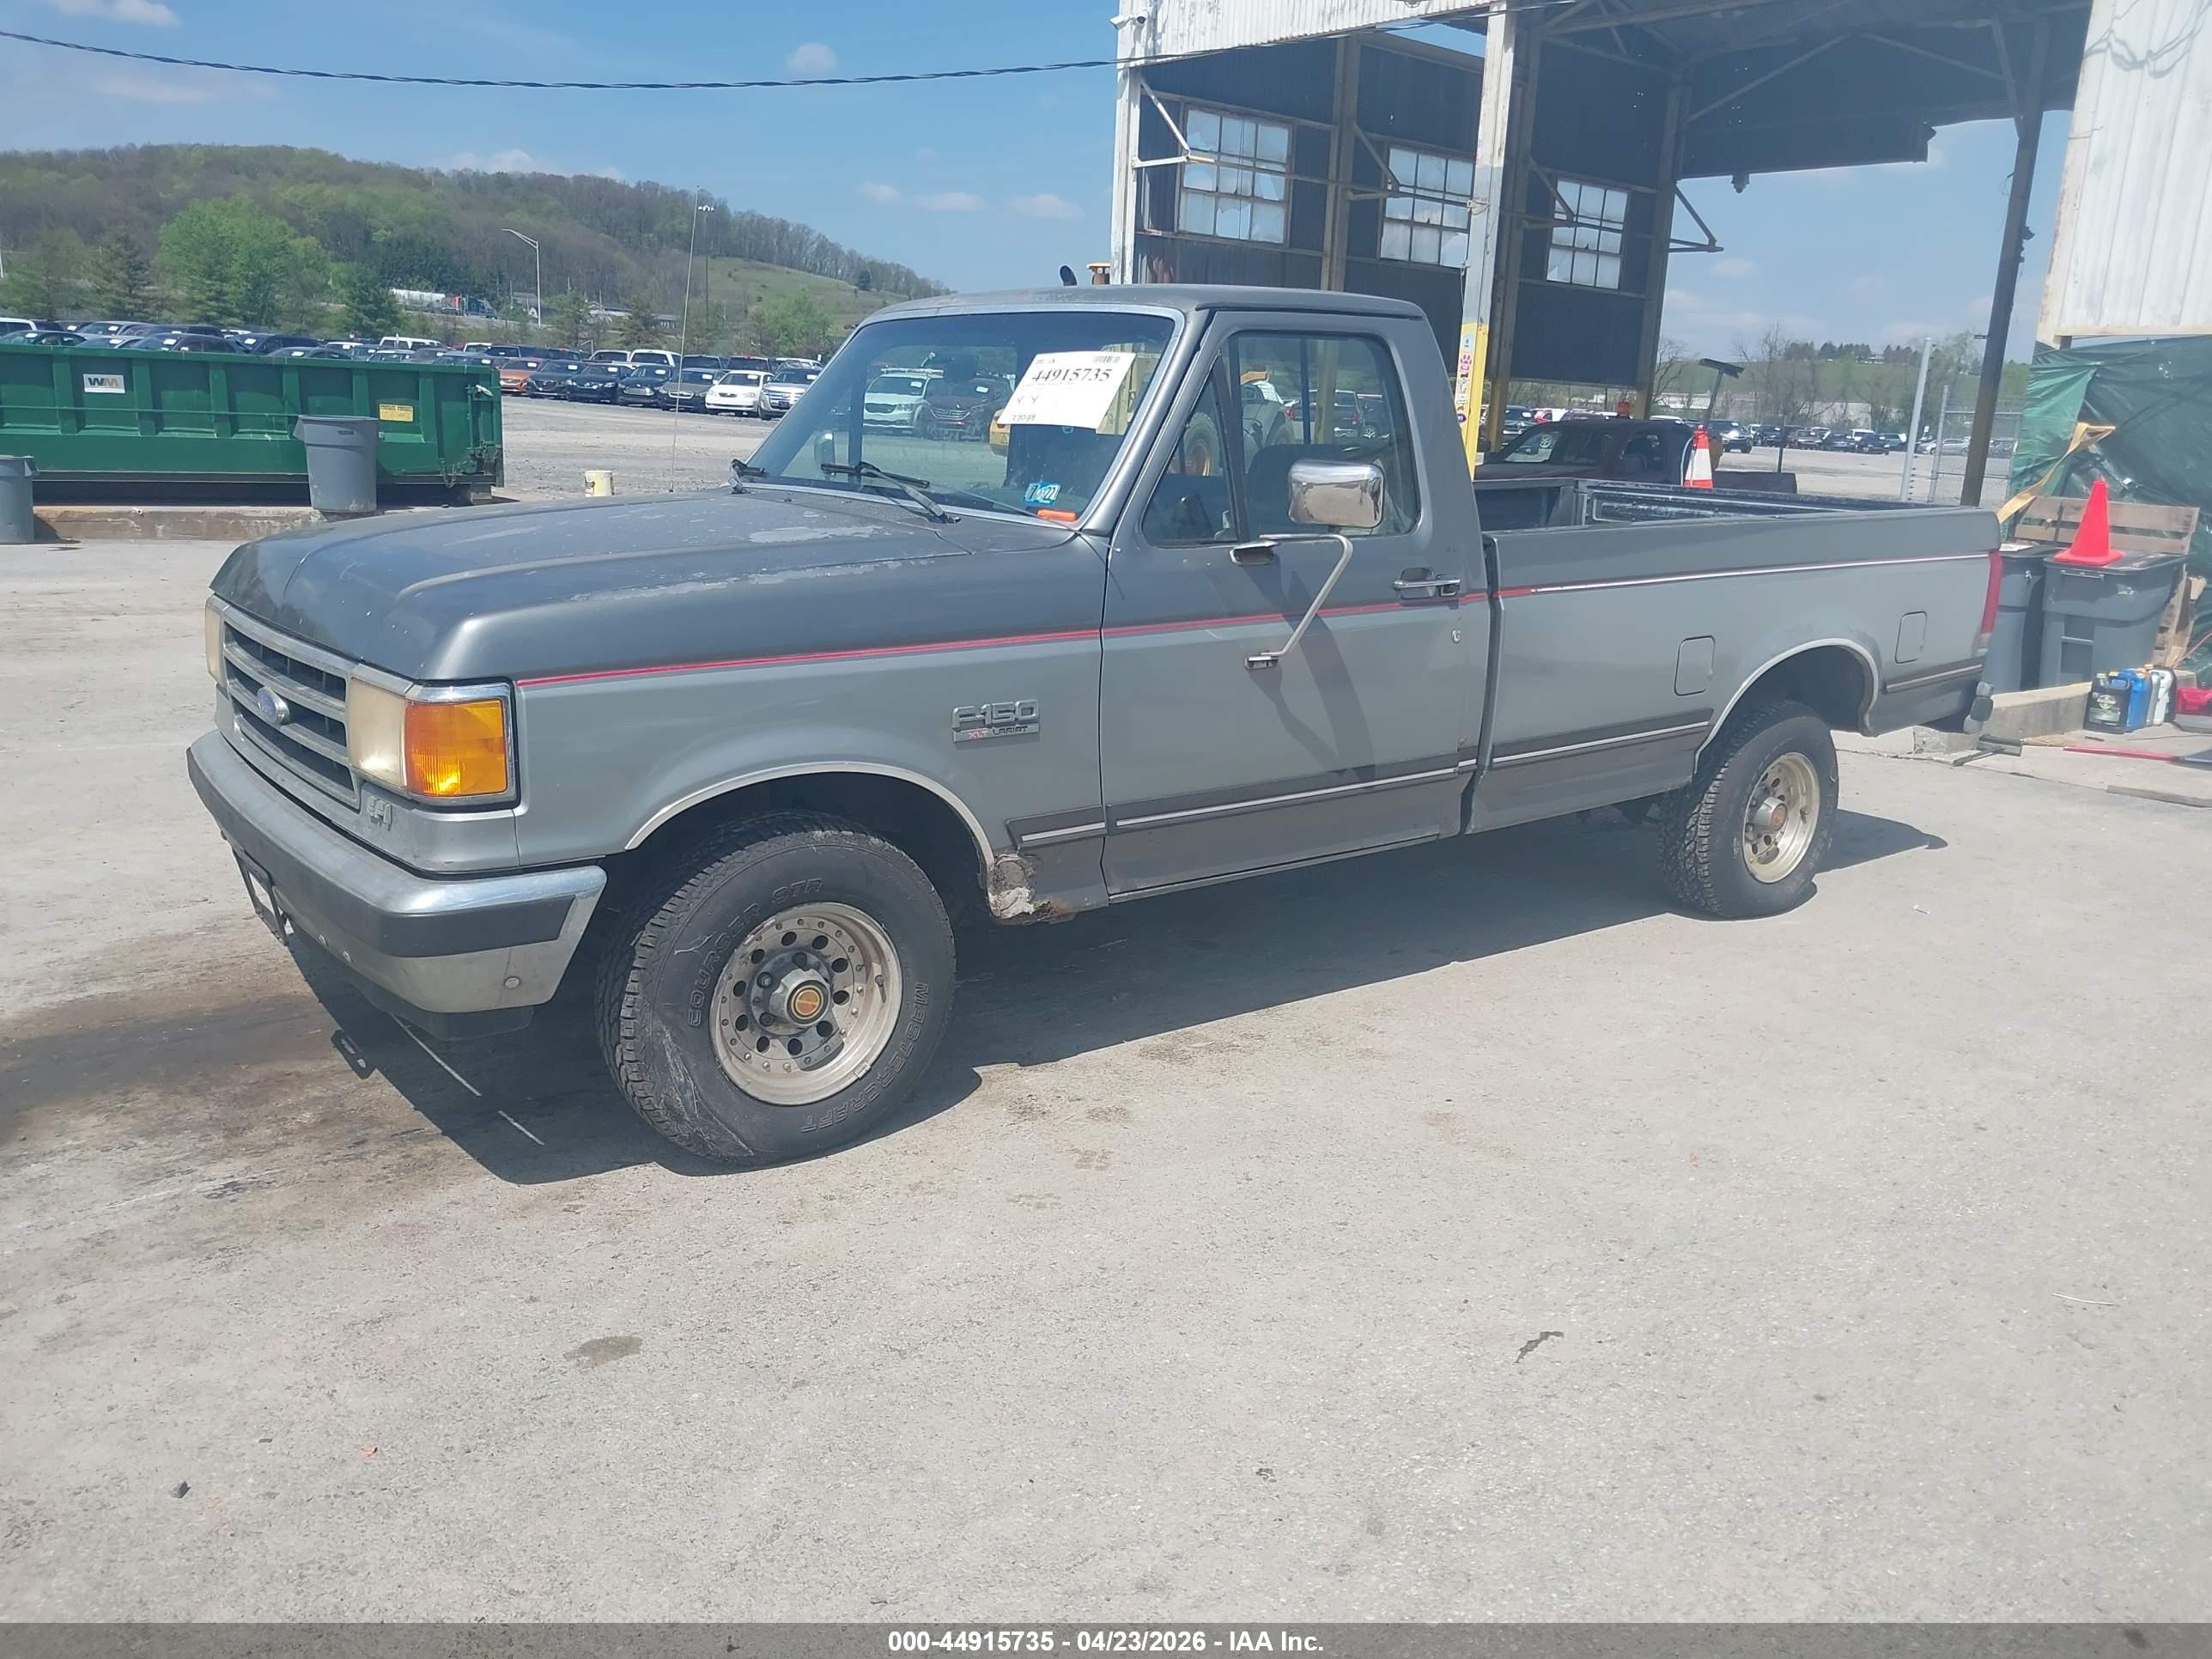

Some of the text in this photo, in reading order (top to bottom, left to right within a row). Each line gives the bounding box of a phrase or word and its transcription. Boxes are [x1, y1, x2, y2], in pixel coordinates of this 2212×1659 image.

[88, 377, 118, 386] WM
[1031, 368, 1113, 382] 44915735
[951, 699, 1038, 728] F-150
[969, 726, 1029, 738] XLT LARIAT
[688, 877, 825, 1028] COURSER STR
[799, 981, 929, 1133] MASTERCRAFT
